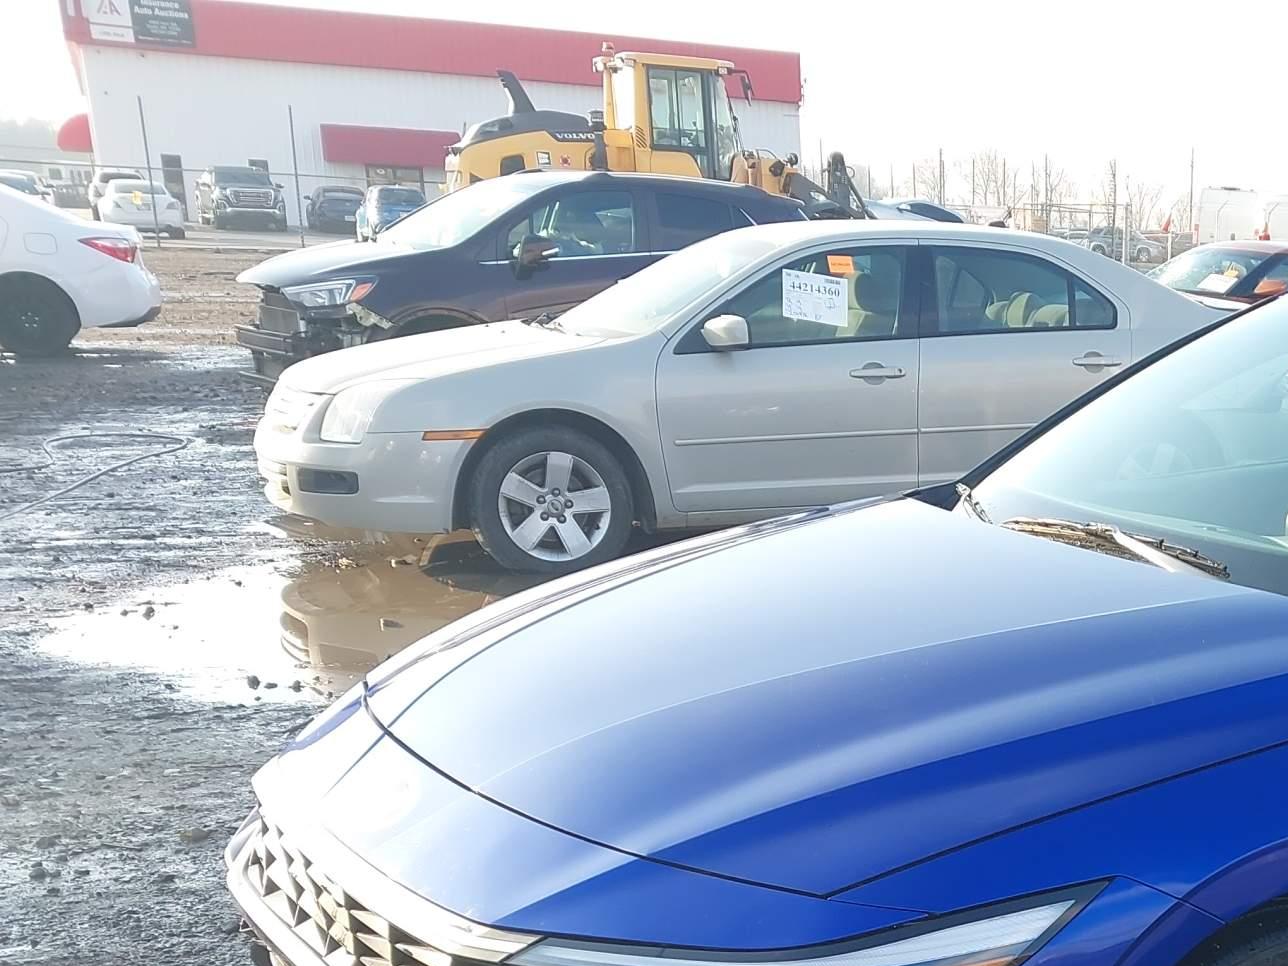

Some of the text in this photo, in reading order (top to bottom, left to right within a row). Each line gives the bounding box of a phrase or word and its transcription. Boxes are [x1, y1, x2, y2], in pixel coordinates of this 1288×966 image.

[134, 5, 189, 19] Auto Auctions
[555, 131, 596, 140] VOLVO
[789, 280, 841, 298] 44214360
